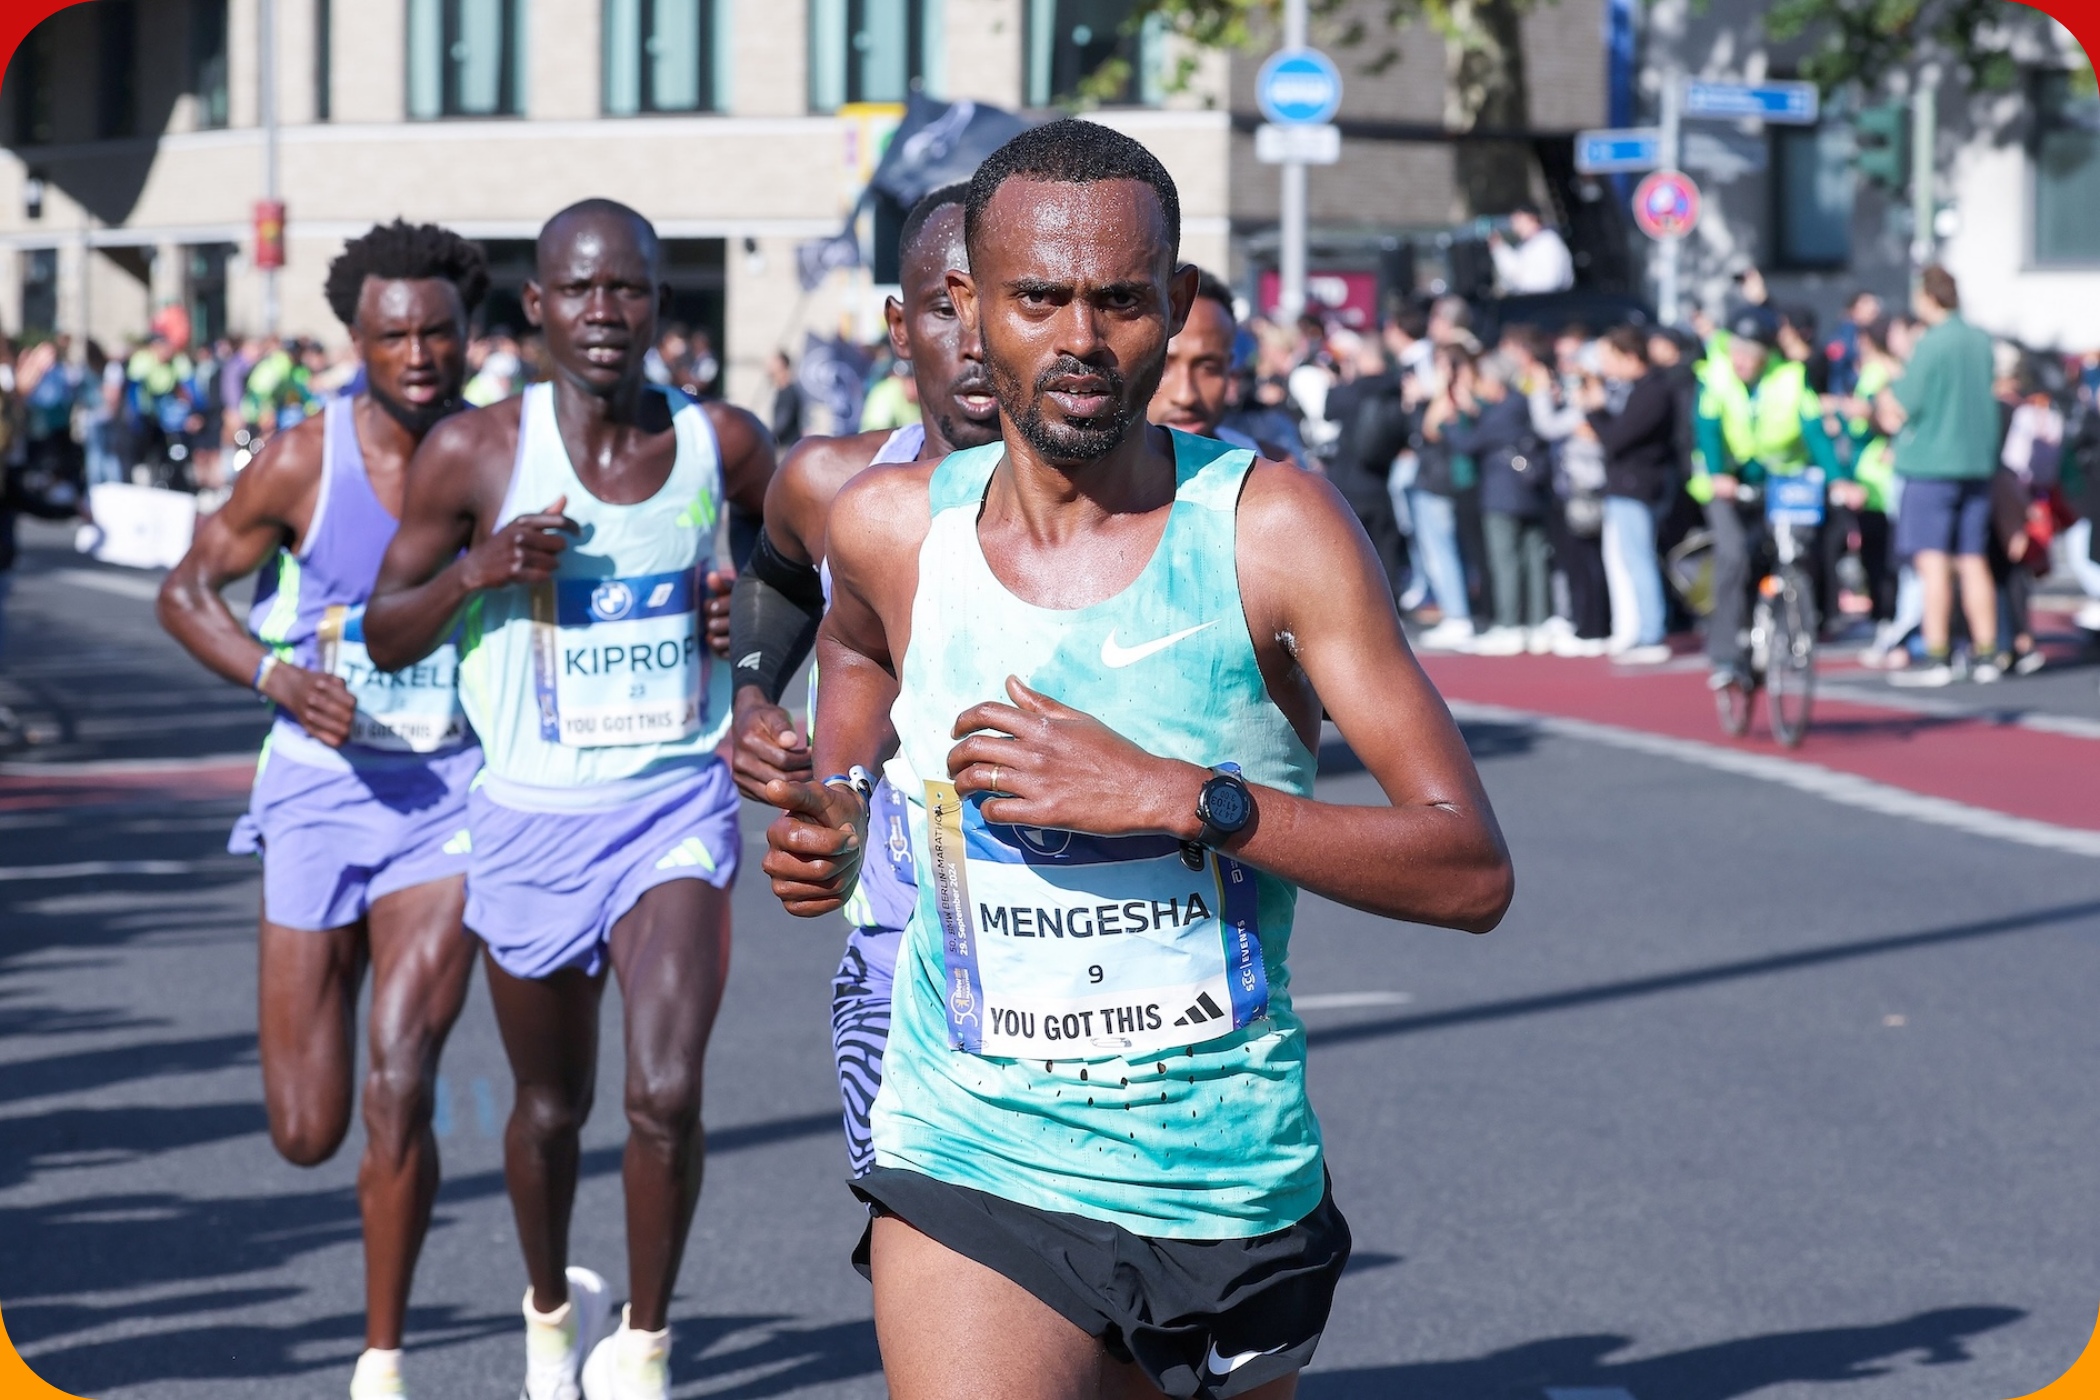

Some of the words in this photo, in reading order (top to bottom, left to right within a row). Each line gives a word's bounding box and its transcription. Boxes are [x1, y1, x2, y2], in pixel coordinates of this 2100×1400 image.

[566, 716, 596, 734] YOU
[602, 714, 634, 732] GOT
[639, 711, 673, 730] THIS
[948, 862, 959, 888] 2024
[952, 889, 967, 939] September
[979, 892, 1211, 938] MENGESHA
[1237, 919, 1251, 963] EVENTS
[1088, 964, 1104, 984] 9
[990, 1007, 1035, 1039] YOU
[1044, 1011, 1093, 1041] GOT
[1100, 1003, 1162, 1034] THIS
